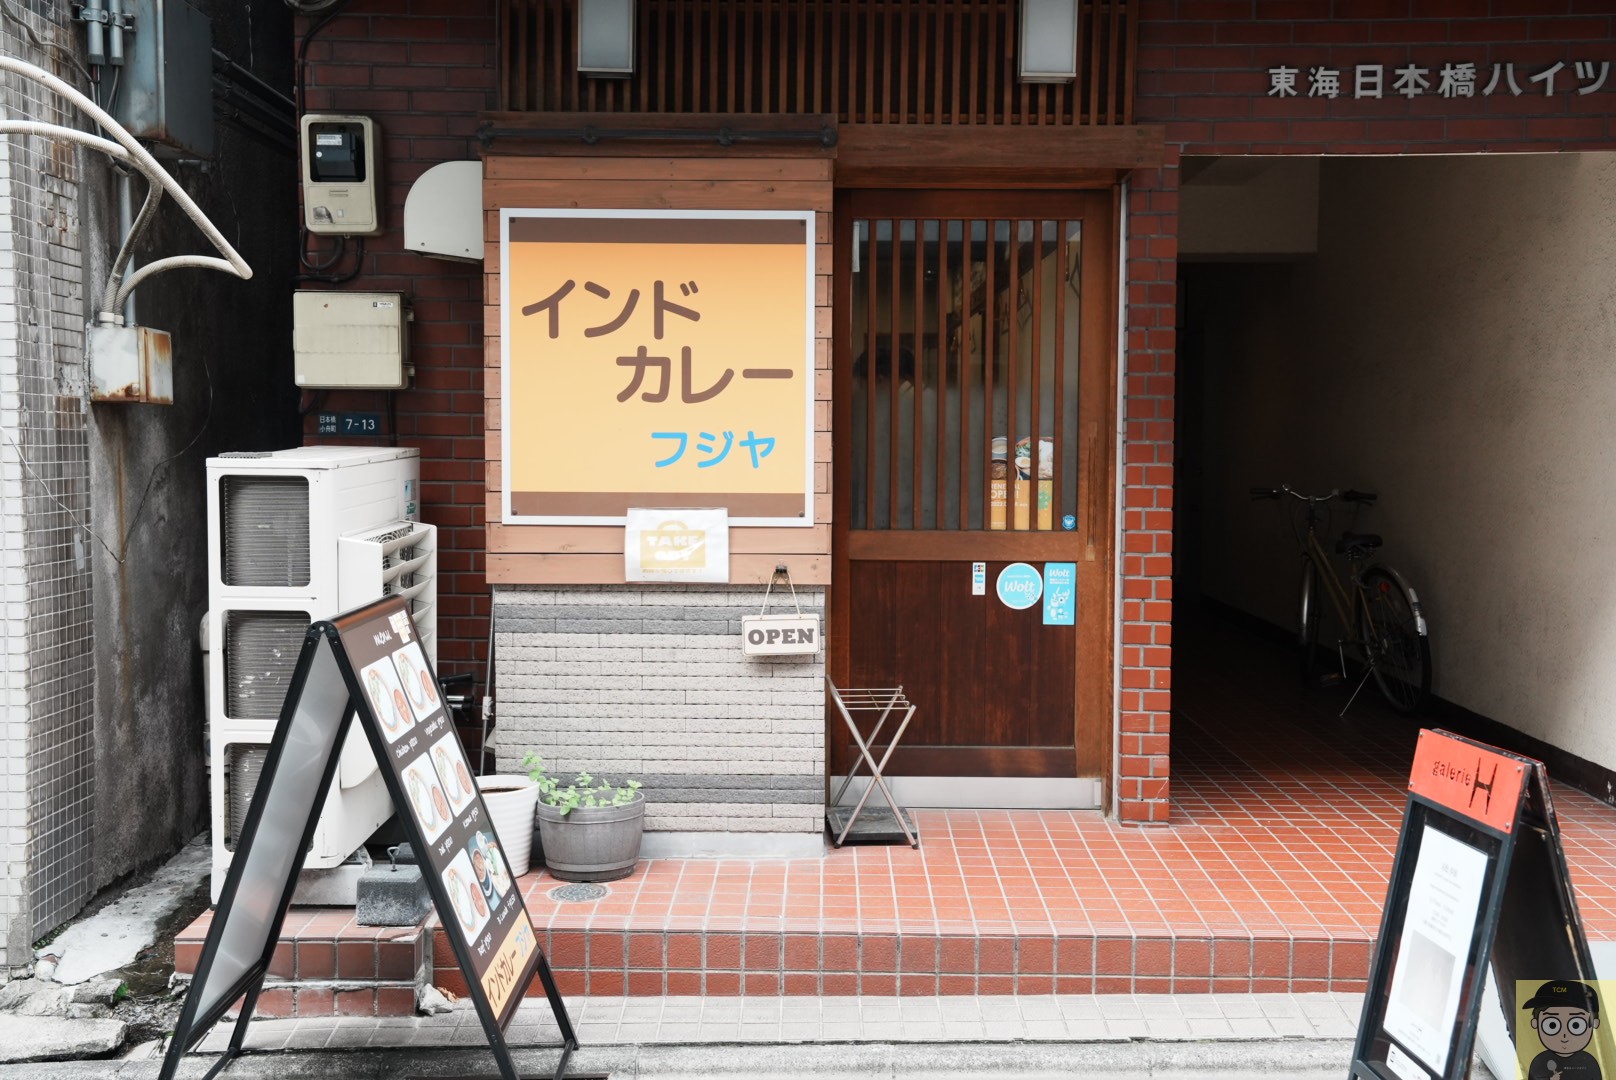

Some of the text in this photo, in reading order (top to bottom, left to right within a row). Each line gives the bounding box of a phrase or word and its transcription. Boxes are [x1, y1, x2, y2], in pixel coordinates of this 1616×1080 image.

[1267, 61, 1610, 99] 東海日本橋ハイツ
[521, 279, 701, 340] インド
[615, 345, 794, 404] カレー
[319, 415, 337, 424] 日本橋
[345, 418, 376, 430] 7-13
[651, 430, 776, 469] フジヤ
[1004, 580, 1036, 593] Wolt
[1049, 568, 1070, 577] Wolt
[747, 628, 815, 645] OPEN
[1431, 757, 1498, 815] galerie H
[487, 950, 517, 1008] インドカレー
